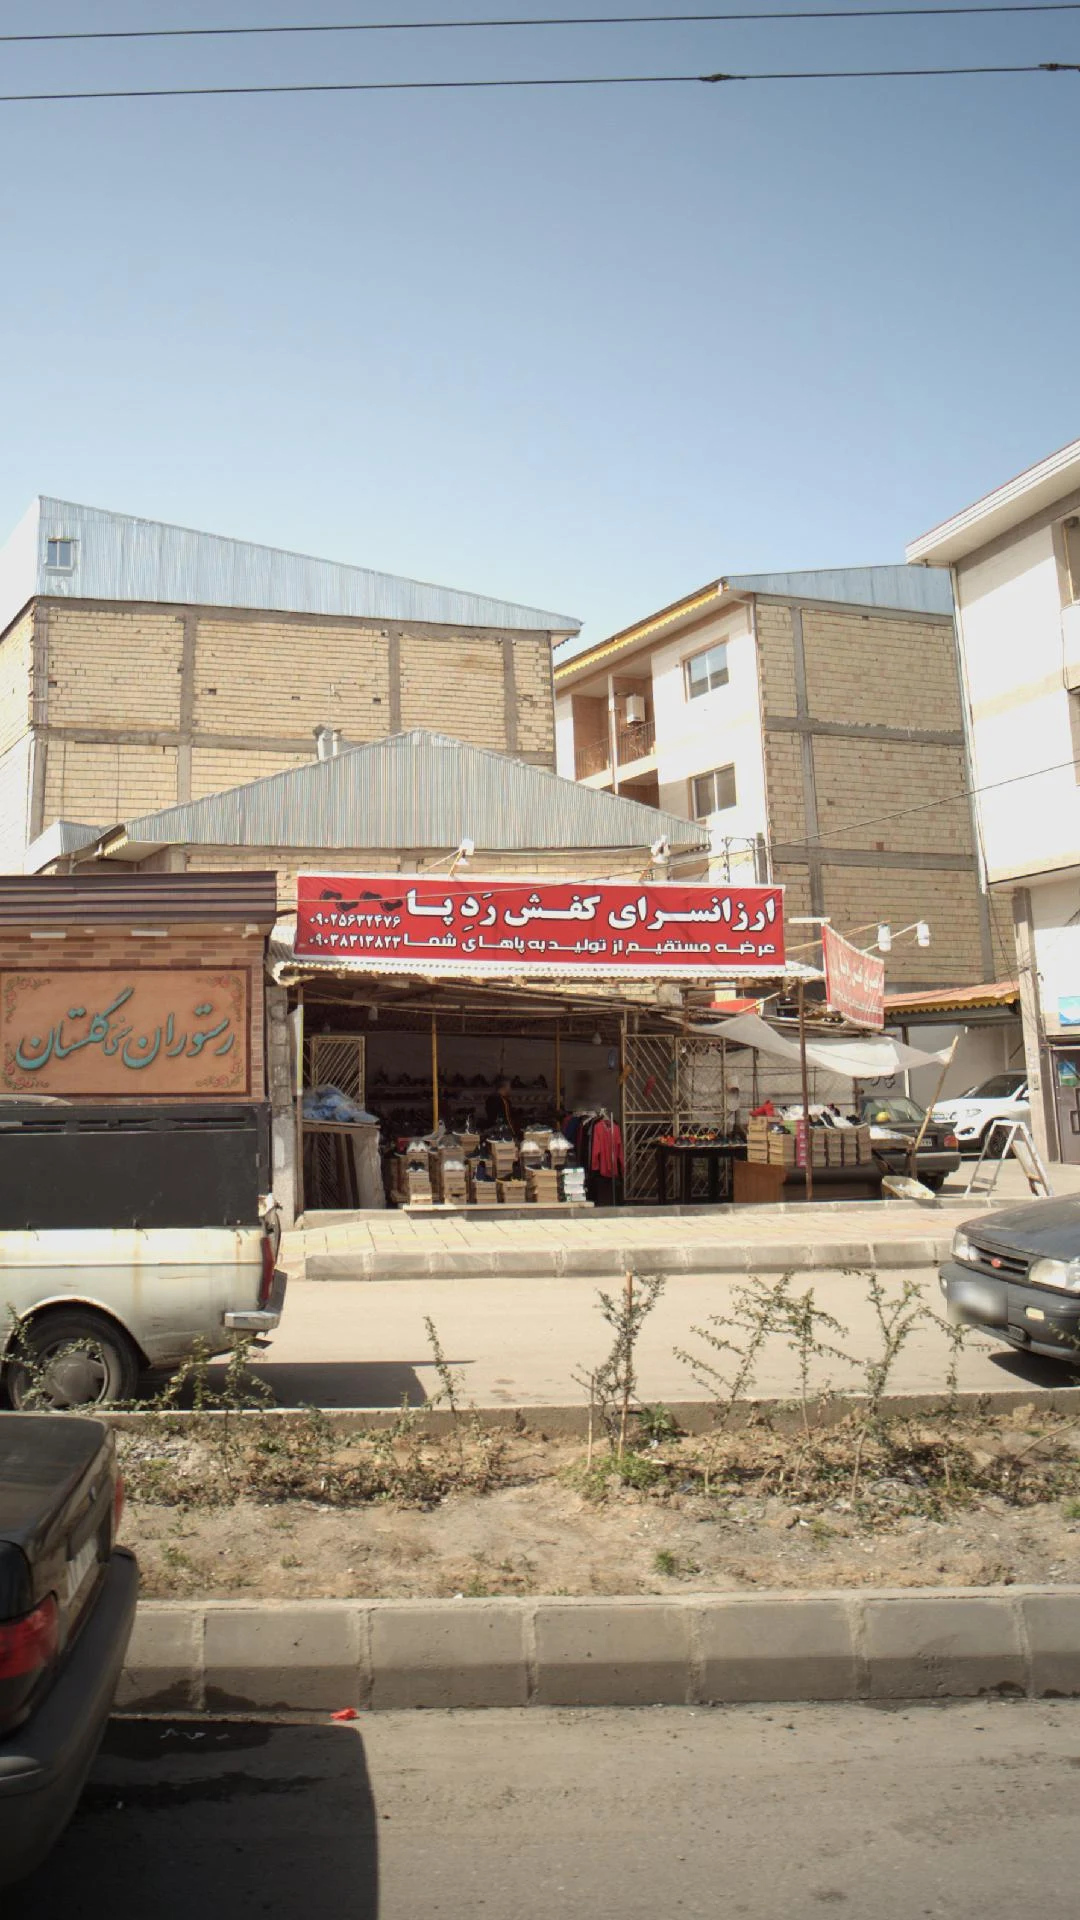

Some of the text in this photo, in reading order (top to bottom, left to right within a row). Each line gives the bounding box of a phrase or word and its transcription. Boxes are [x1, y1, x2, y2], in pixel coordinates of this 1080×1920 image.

[405, 888, 454, 927] پا
[503, 893, 602, 928] کفش
[607, 896, 776, 932] ارزانسرای
[403, 931, 777, 957] عرضه مستقیم از تولید به پاهای شما
[15, 985, 135, 1071] گلستان
[121, 1001, 236, 1071] رستوران
